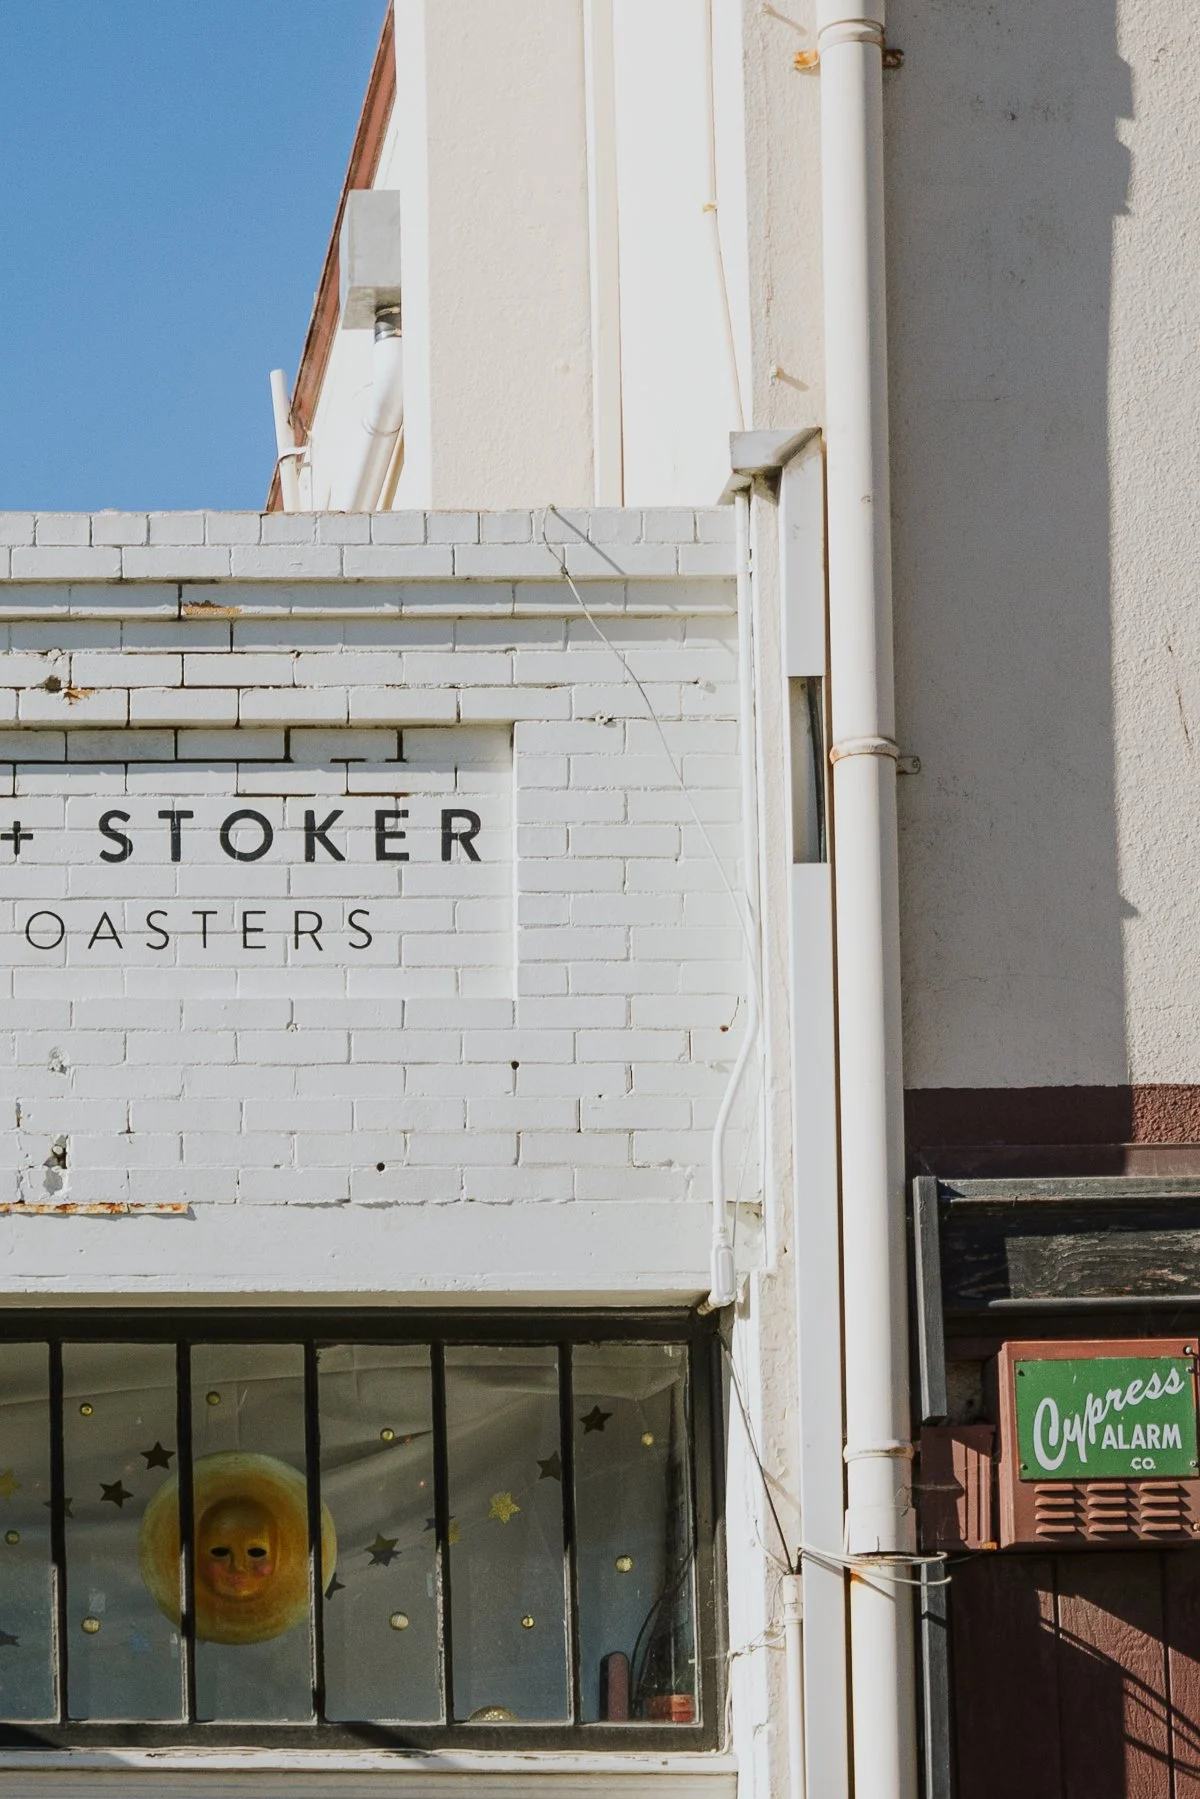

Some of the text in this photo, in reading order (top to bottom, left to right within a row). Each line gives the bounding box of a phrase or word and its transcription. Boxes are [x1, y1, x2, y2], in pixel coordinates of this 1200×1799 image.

[0, 821, 35, 858] +
[99, 809, 483, 864] STOKER
[1033, 1367, 1185, 1471] Cypress
[1101, 1423, 1183, 1450] ALARM
